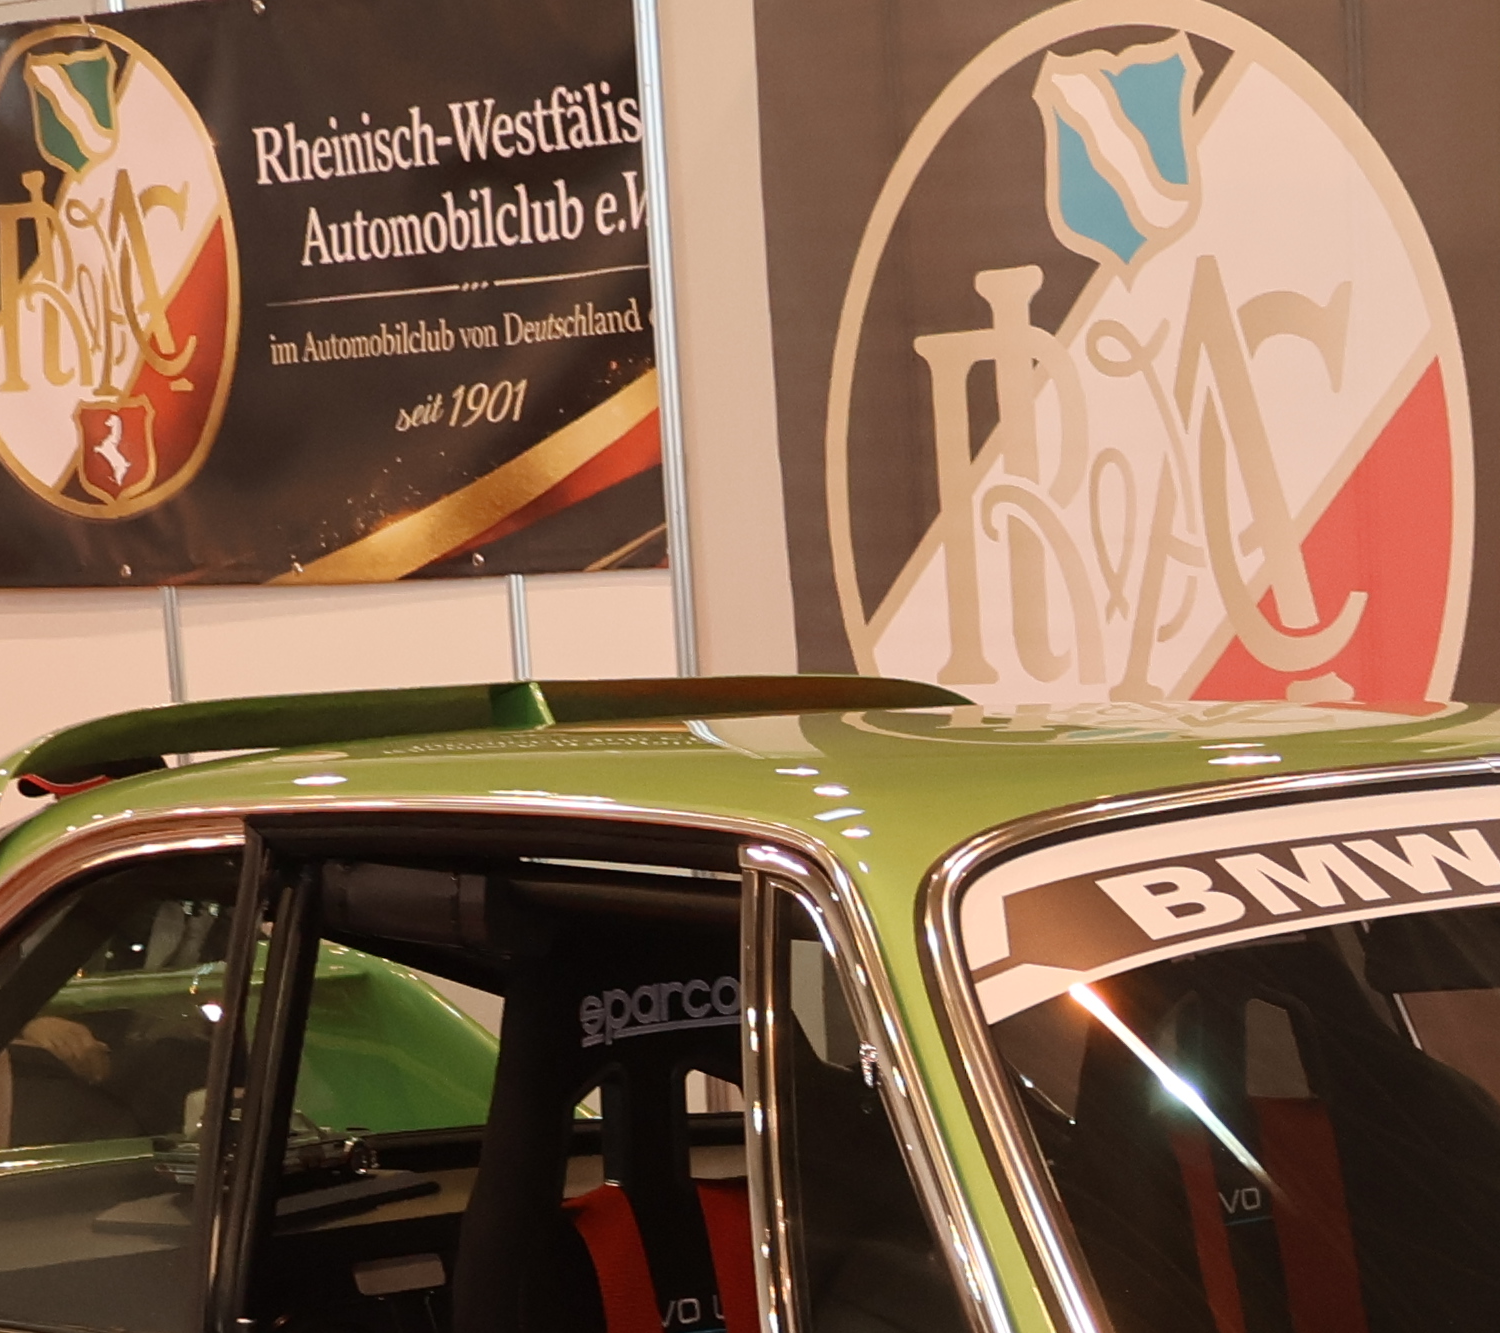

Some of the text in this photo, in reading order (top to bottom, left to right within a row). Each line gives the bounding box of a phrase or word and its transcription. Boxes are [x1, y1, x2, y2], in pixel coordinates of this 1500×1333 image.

[300, 179, 585, 267] Automobilclub
[269, 333, 299, 366] im
[302, 317, 456, 364] Automobilclub
[458, 323, 498, 351] von
[503, 297, 643, 347] Deutschland
[395, 378, 529, 431] seit 1901
[580, 975, 742, 1045] sparco
